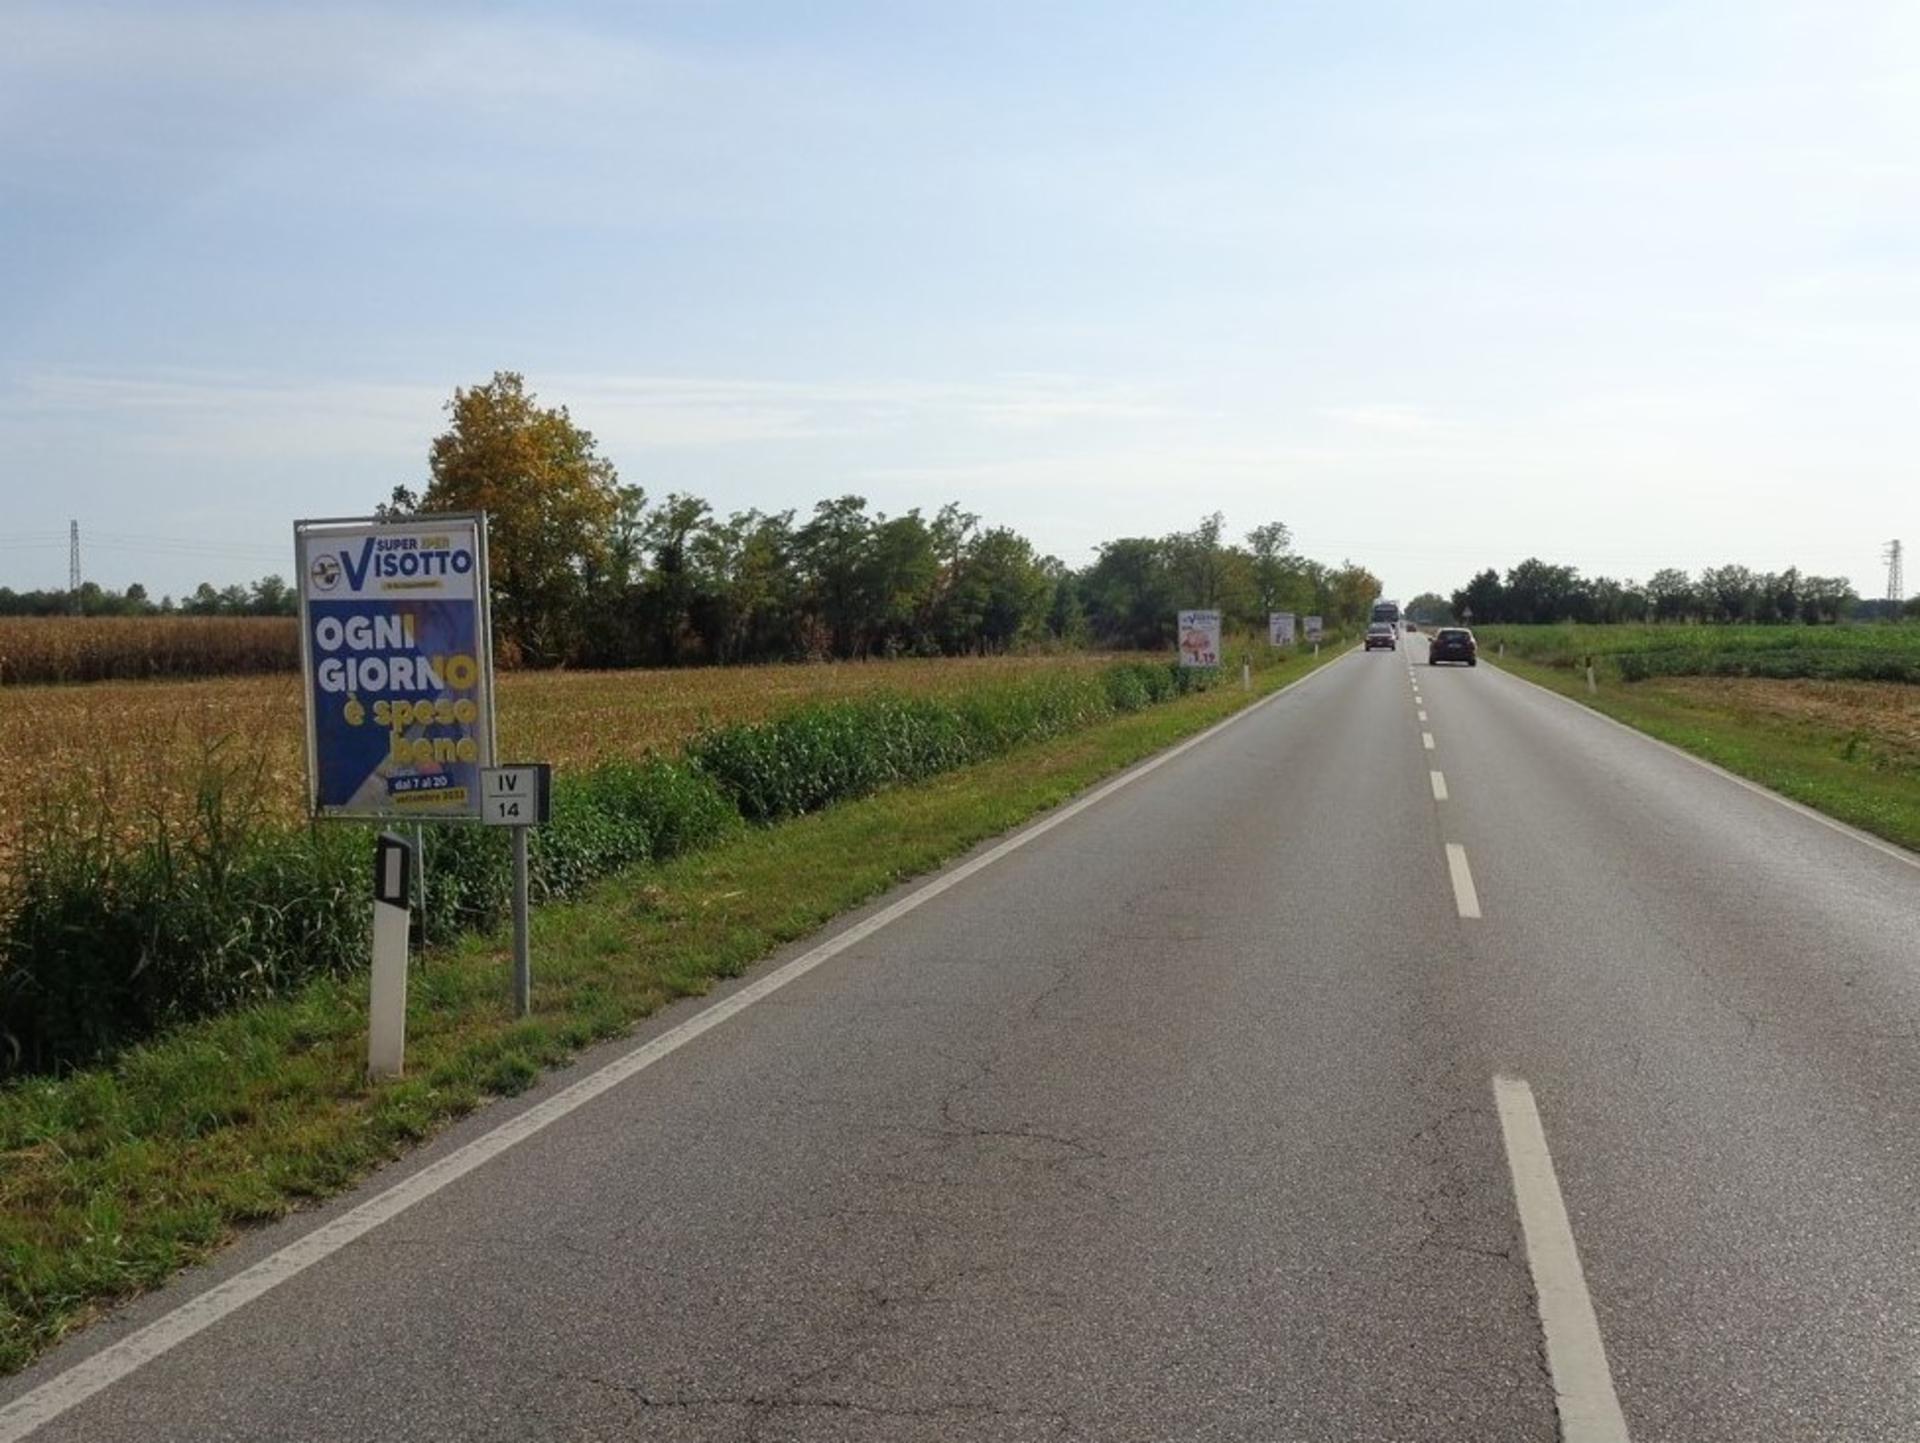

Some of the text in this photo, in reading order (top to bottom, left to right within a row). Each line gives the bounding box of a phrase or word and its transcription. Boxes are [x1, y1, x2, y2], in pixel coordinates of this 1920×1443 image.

[377, 538, 418, 551] SUPER
[340, 537, 473, 591] VISOTTO
[316, 614, 415, 650] OGNI
[318, 655, 477, 692] GIORNO
[372, 698, 478, 733] speso
[413, 778, 419, 788] 7
[433, 775, 448, 787] 20
[499, 774, 517, 792] IV
[499, 802, 519, 818] 14
